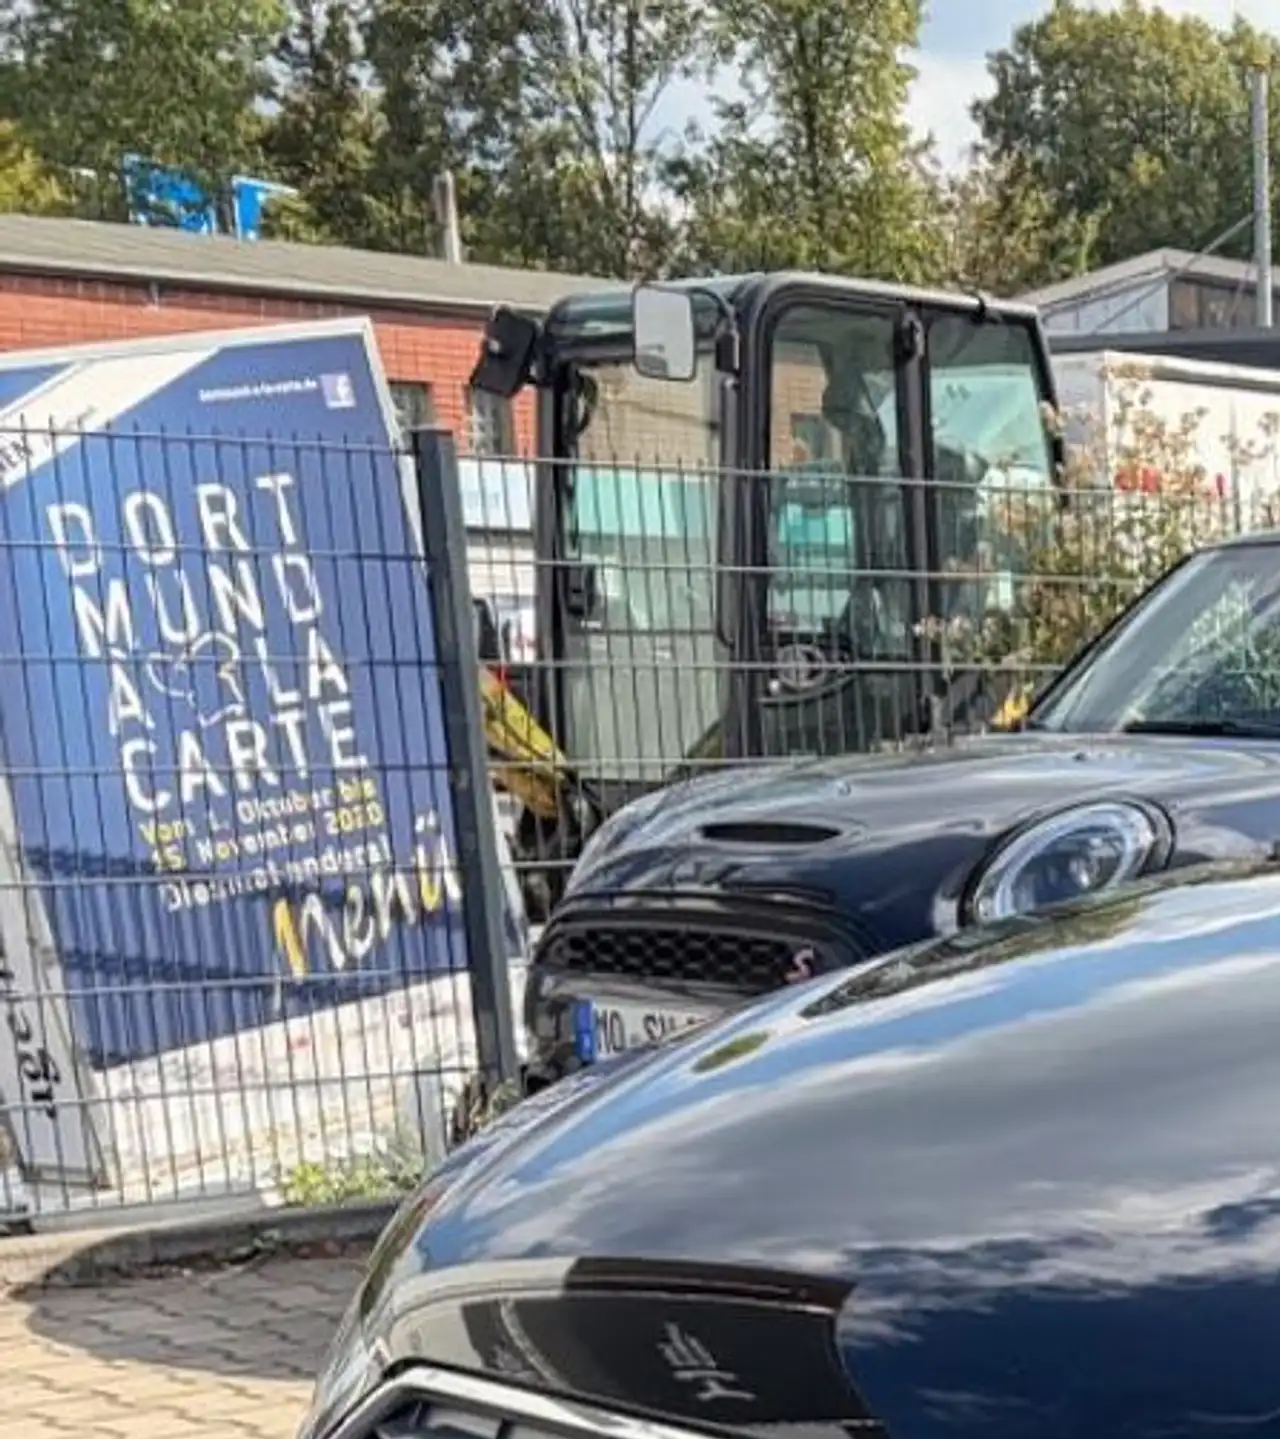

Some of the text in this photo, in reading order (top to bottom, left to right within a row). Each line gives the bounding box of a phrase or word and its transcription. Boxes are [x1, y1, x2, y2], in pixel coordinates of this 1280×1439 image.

[46, 473, 298, 577] DORT
[73, 554, 323, 658] MUND
[254, 627, 348, 705] LA
[121, 700, 368, 812] CARTE
